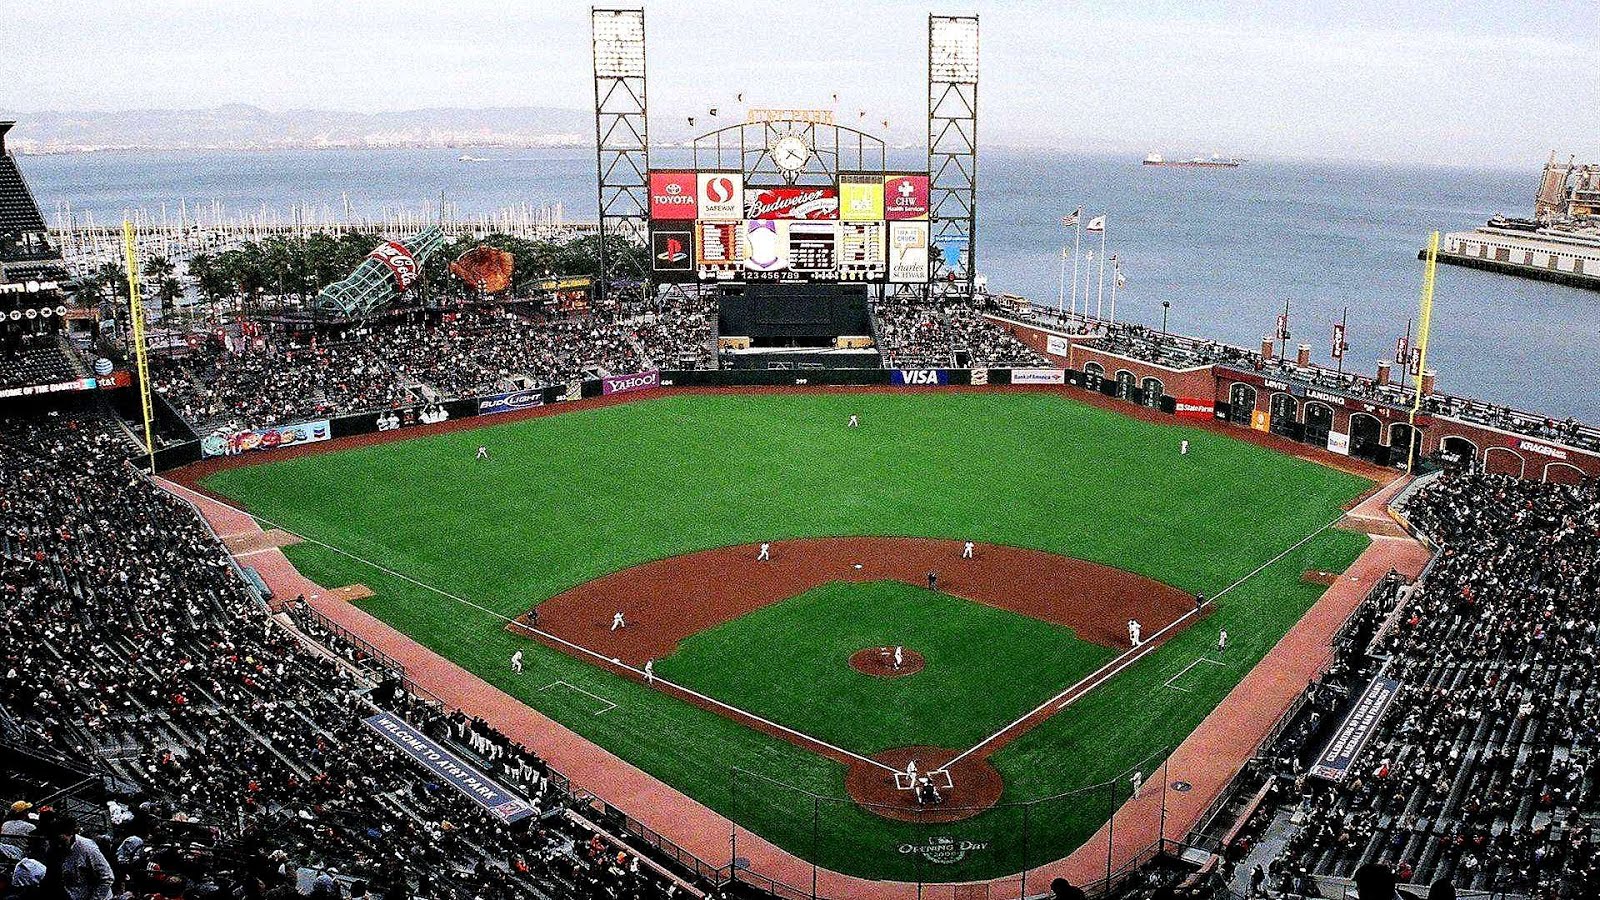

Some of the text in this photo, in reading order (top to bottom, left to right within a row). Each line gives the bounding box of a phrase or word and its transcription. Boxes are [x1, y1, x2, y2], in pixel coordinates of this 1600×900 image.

[654, 196, 694, 204] TOYOTA
[745, 190, 824, 218] Budweiser
[895, 197, 916, 206] CHW
[893, 261, 924, 272] charles
[609, 374, 656, 392] YAHOO!
[901, 370, 938, 384] VISA
[480, 393, 542, 409] BUD LIGHT
[1306, 389, 1345, 406] LANDING
[1200, 404, 1213, 413] Farm
[1519, 441, 1552, 456] KRAGEN
[377, 718, 499, 800] WELCOME TO AT&T PARK
[960, 840, 988, 850] DAY
